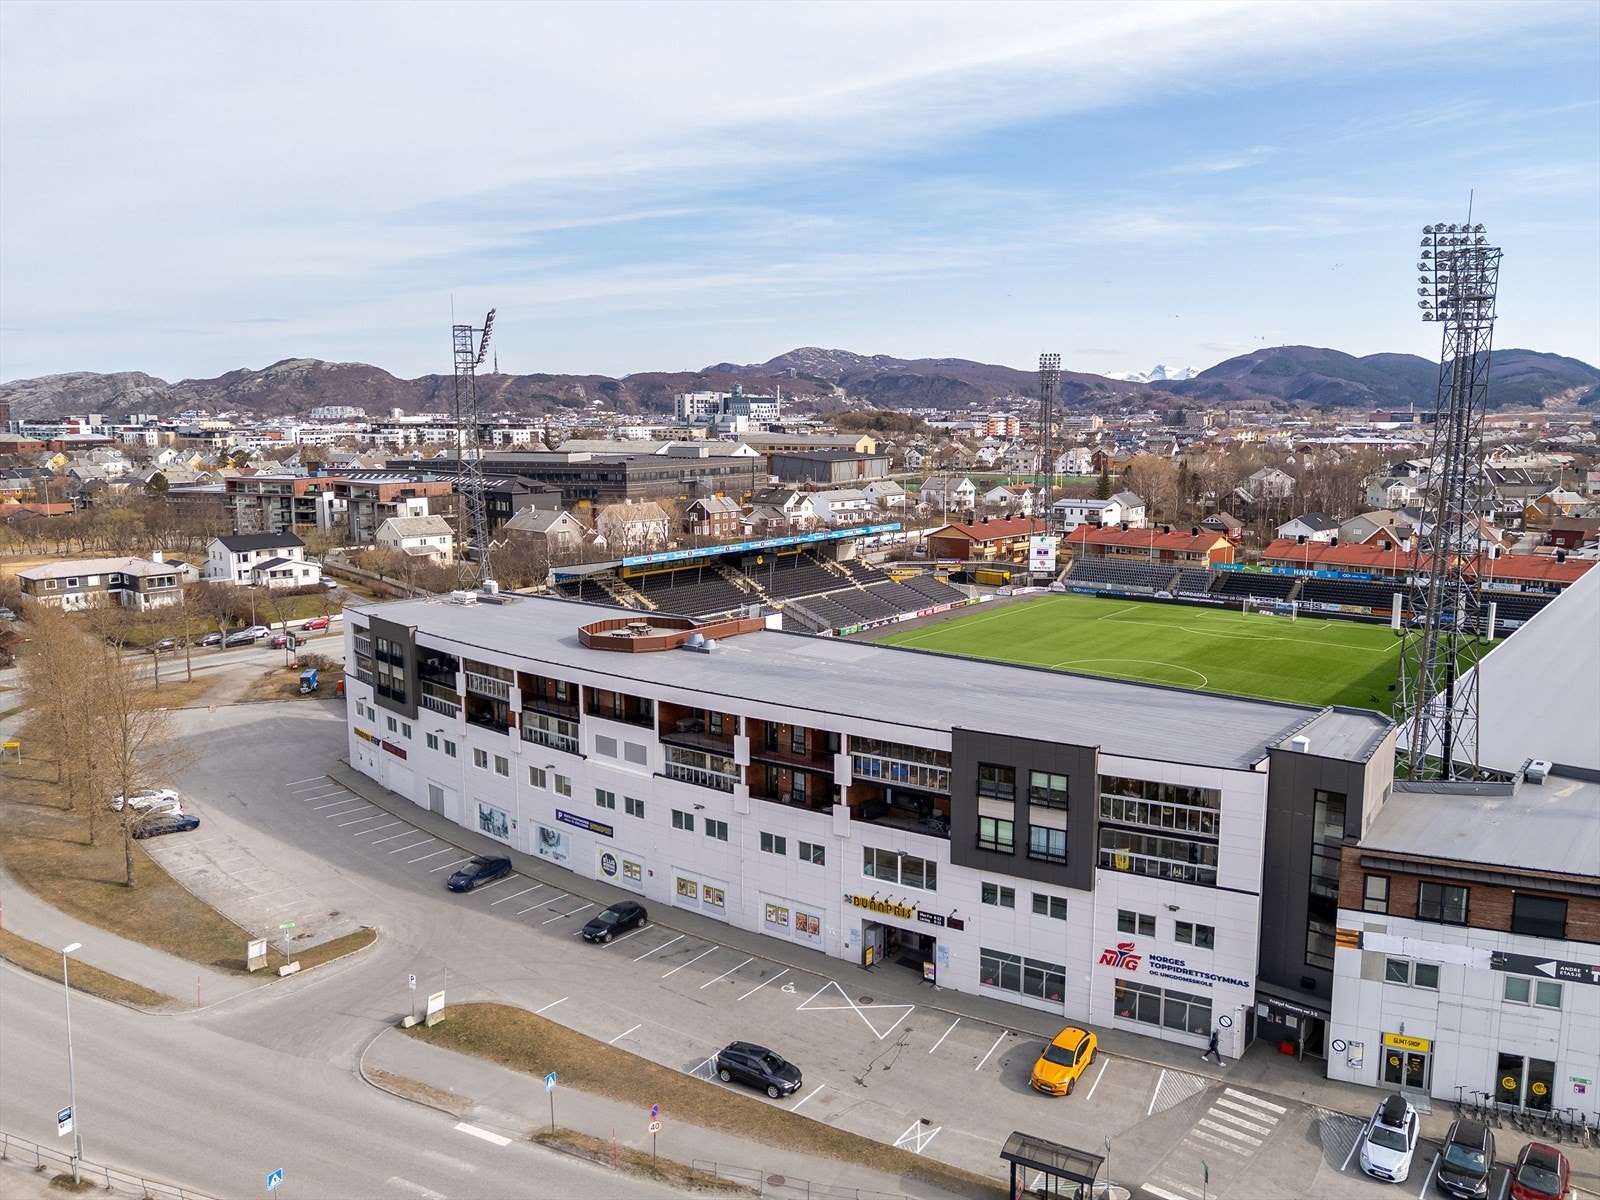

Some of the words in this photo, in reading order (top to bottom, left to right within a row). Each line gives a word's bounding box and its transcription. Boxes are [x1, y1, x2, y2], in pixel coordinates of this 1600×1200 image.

[1293, 569, 1318, 577] HAVET
[853, 896, 913, 919] BUNNPRIS
[1149, 954, 1186, 967] NORGES
[1149, 961, 1250, 988] TOPPIDRETTSGYMNAS
[1160, 972, 1213, 988] UNGDOMSSKOLE
[1560, 970, 1582, 978] ETASJE
[1393, 1037, 1422, 1048] GLIMT-SHOP
[650, 1122, 660, 1131] 40
